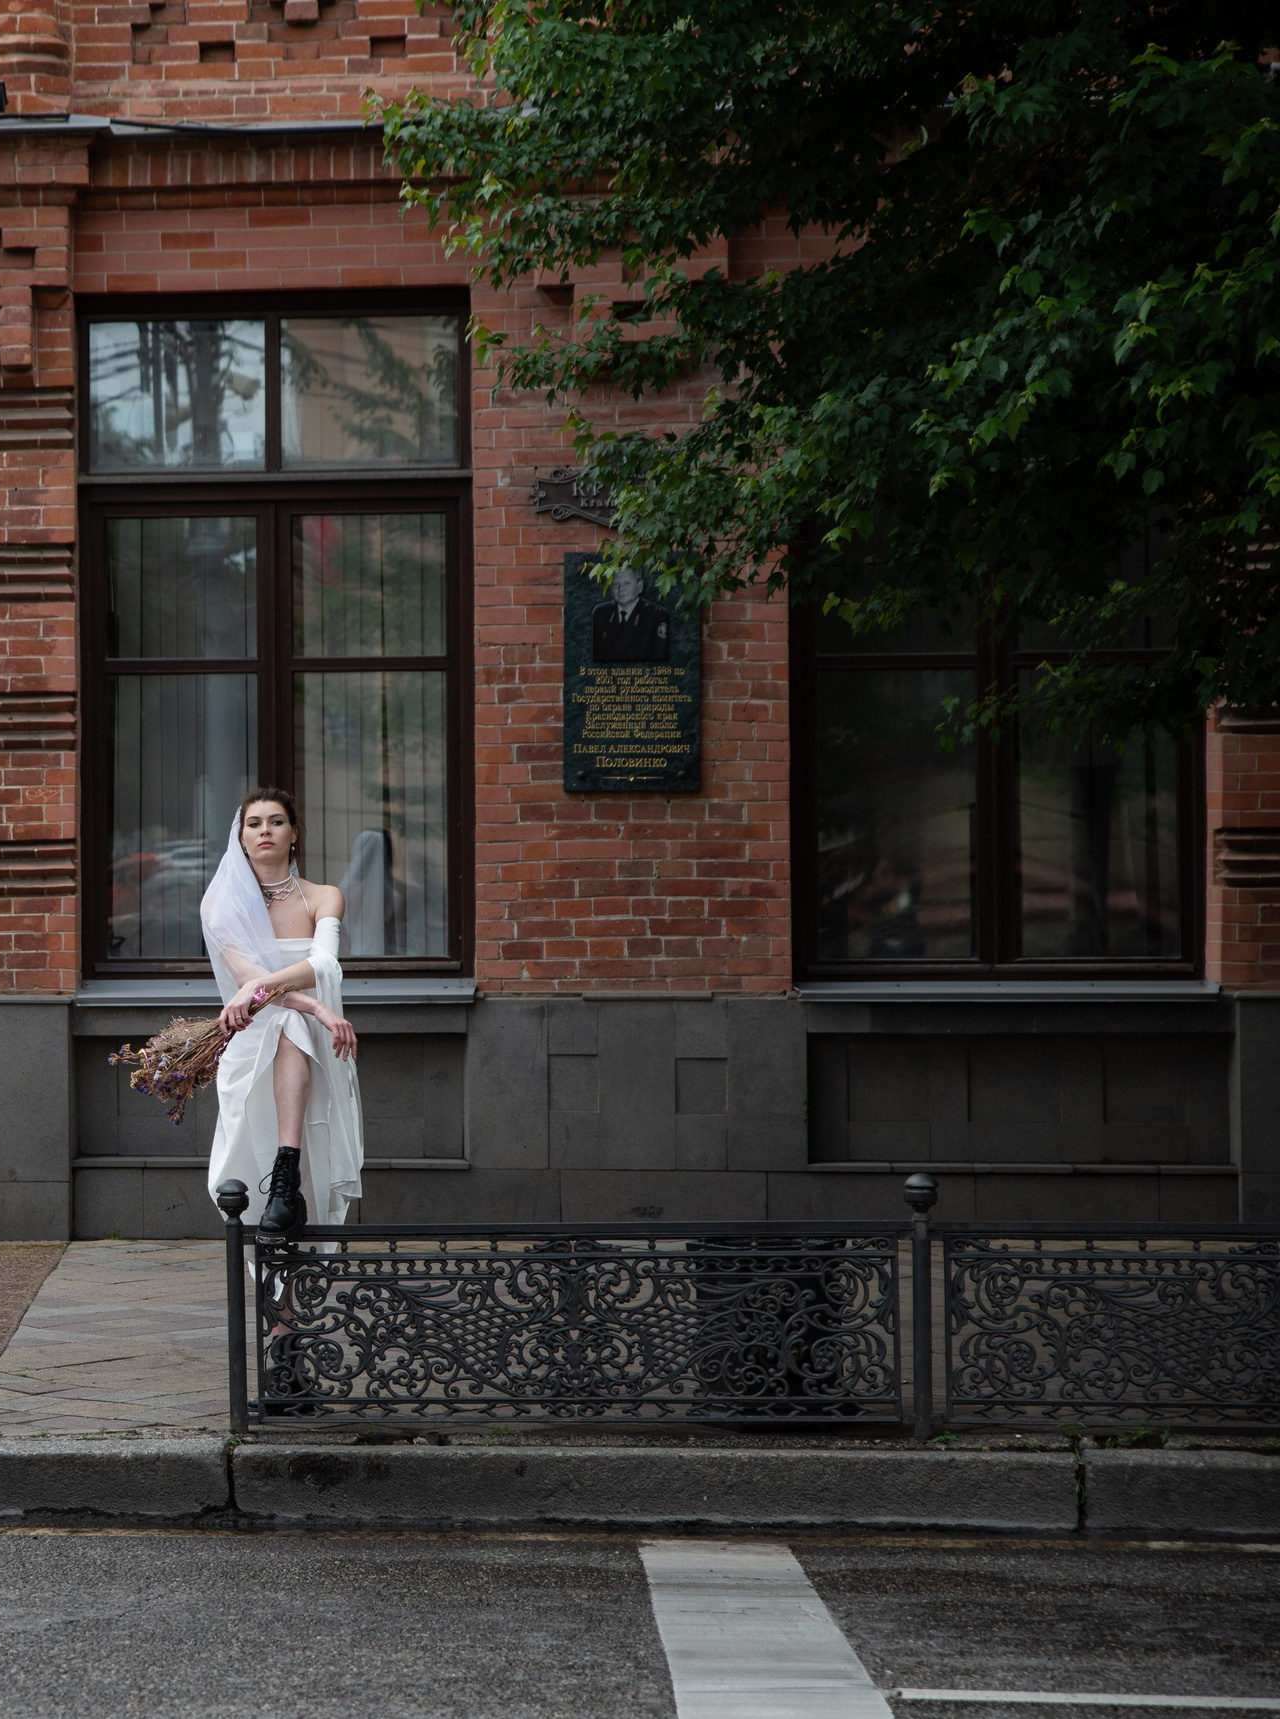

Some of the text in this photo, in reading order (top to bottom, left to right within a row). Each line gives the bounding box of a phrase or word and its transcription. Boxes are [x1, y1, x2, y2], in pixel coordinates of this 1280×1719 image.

[580, 666, 586, 676] В
[588, 667, 608, 676] этом
[611, 667, 643, 676] здании
[653, 666, 672, 675] 1988
[674, 667, 685, 675] по
[595, 675, 668, 686] 2001 год работал
[584, 685, 680, 695] первый руководитель
[572, 693, 649, 704] Государственного
[602, 704, 632, 713] охране
[635, 704, 674, 713] природы
[585, 711, 678, 722] Краснодарского края
[585, 721, 646, 730] Заслуженный
[582, 729, 682, 740] Российской Федерации
